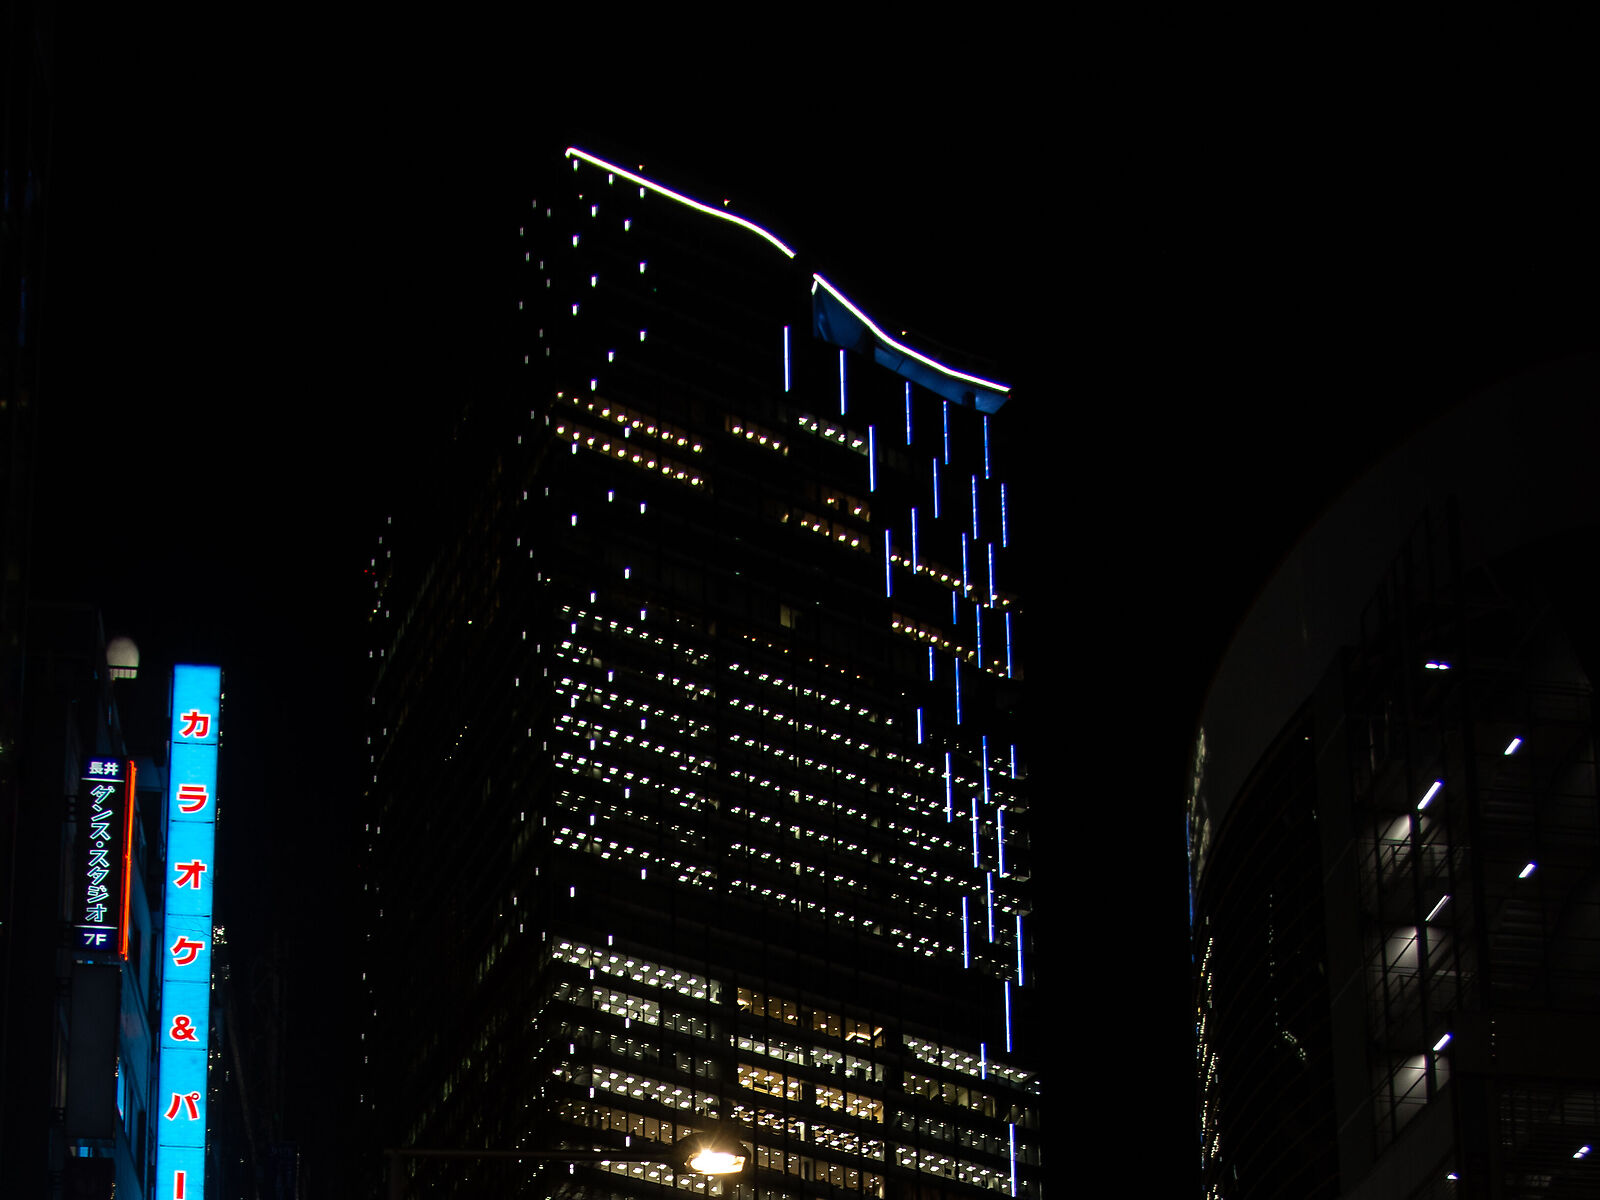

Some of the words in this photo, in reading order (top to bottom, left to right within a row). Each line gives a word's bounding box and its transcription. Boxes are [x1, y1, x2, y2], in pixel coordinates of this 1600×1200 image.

[89, 761, 118, 775] 長井
[85, 784, 116, 922] ダンス・スタジオ
[84, 933, 106, 946] 7F
